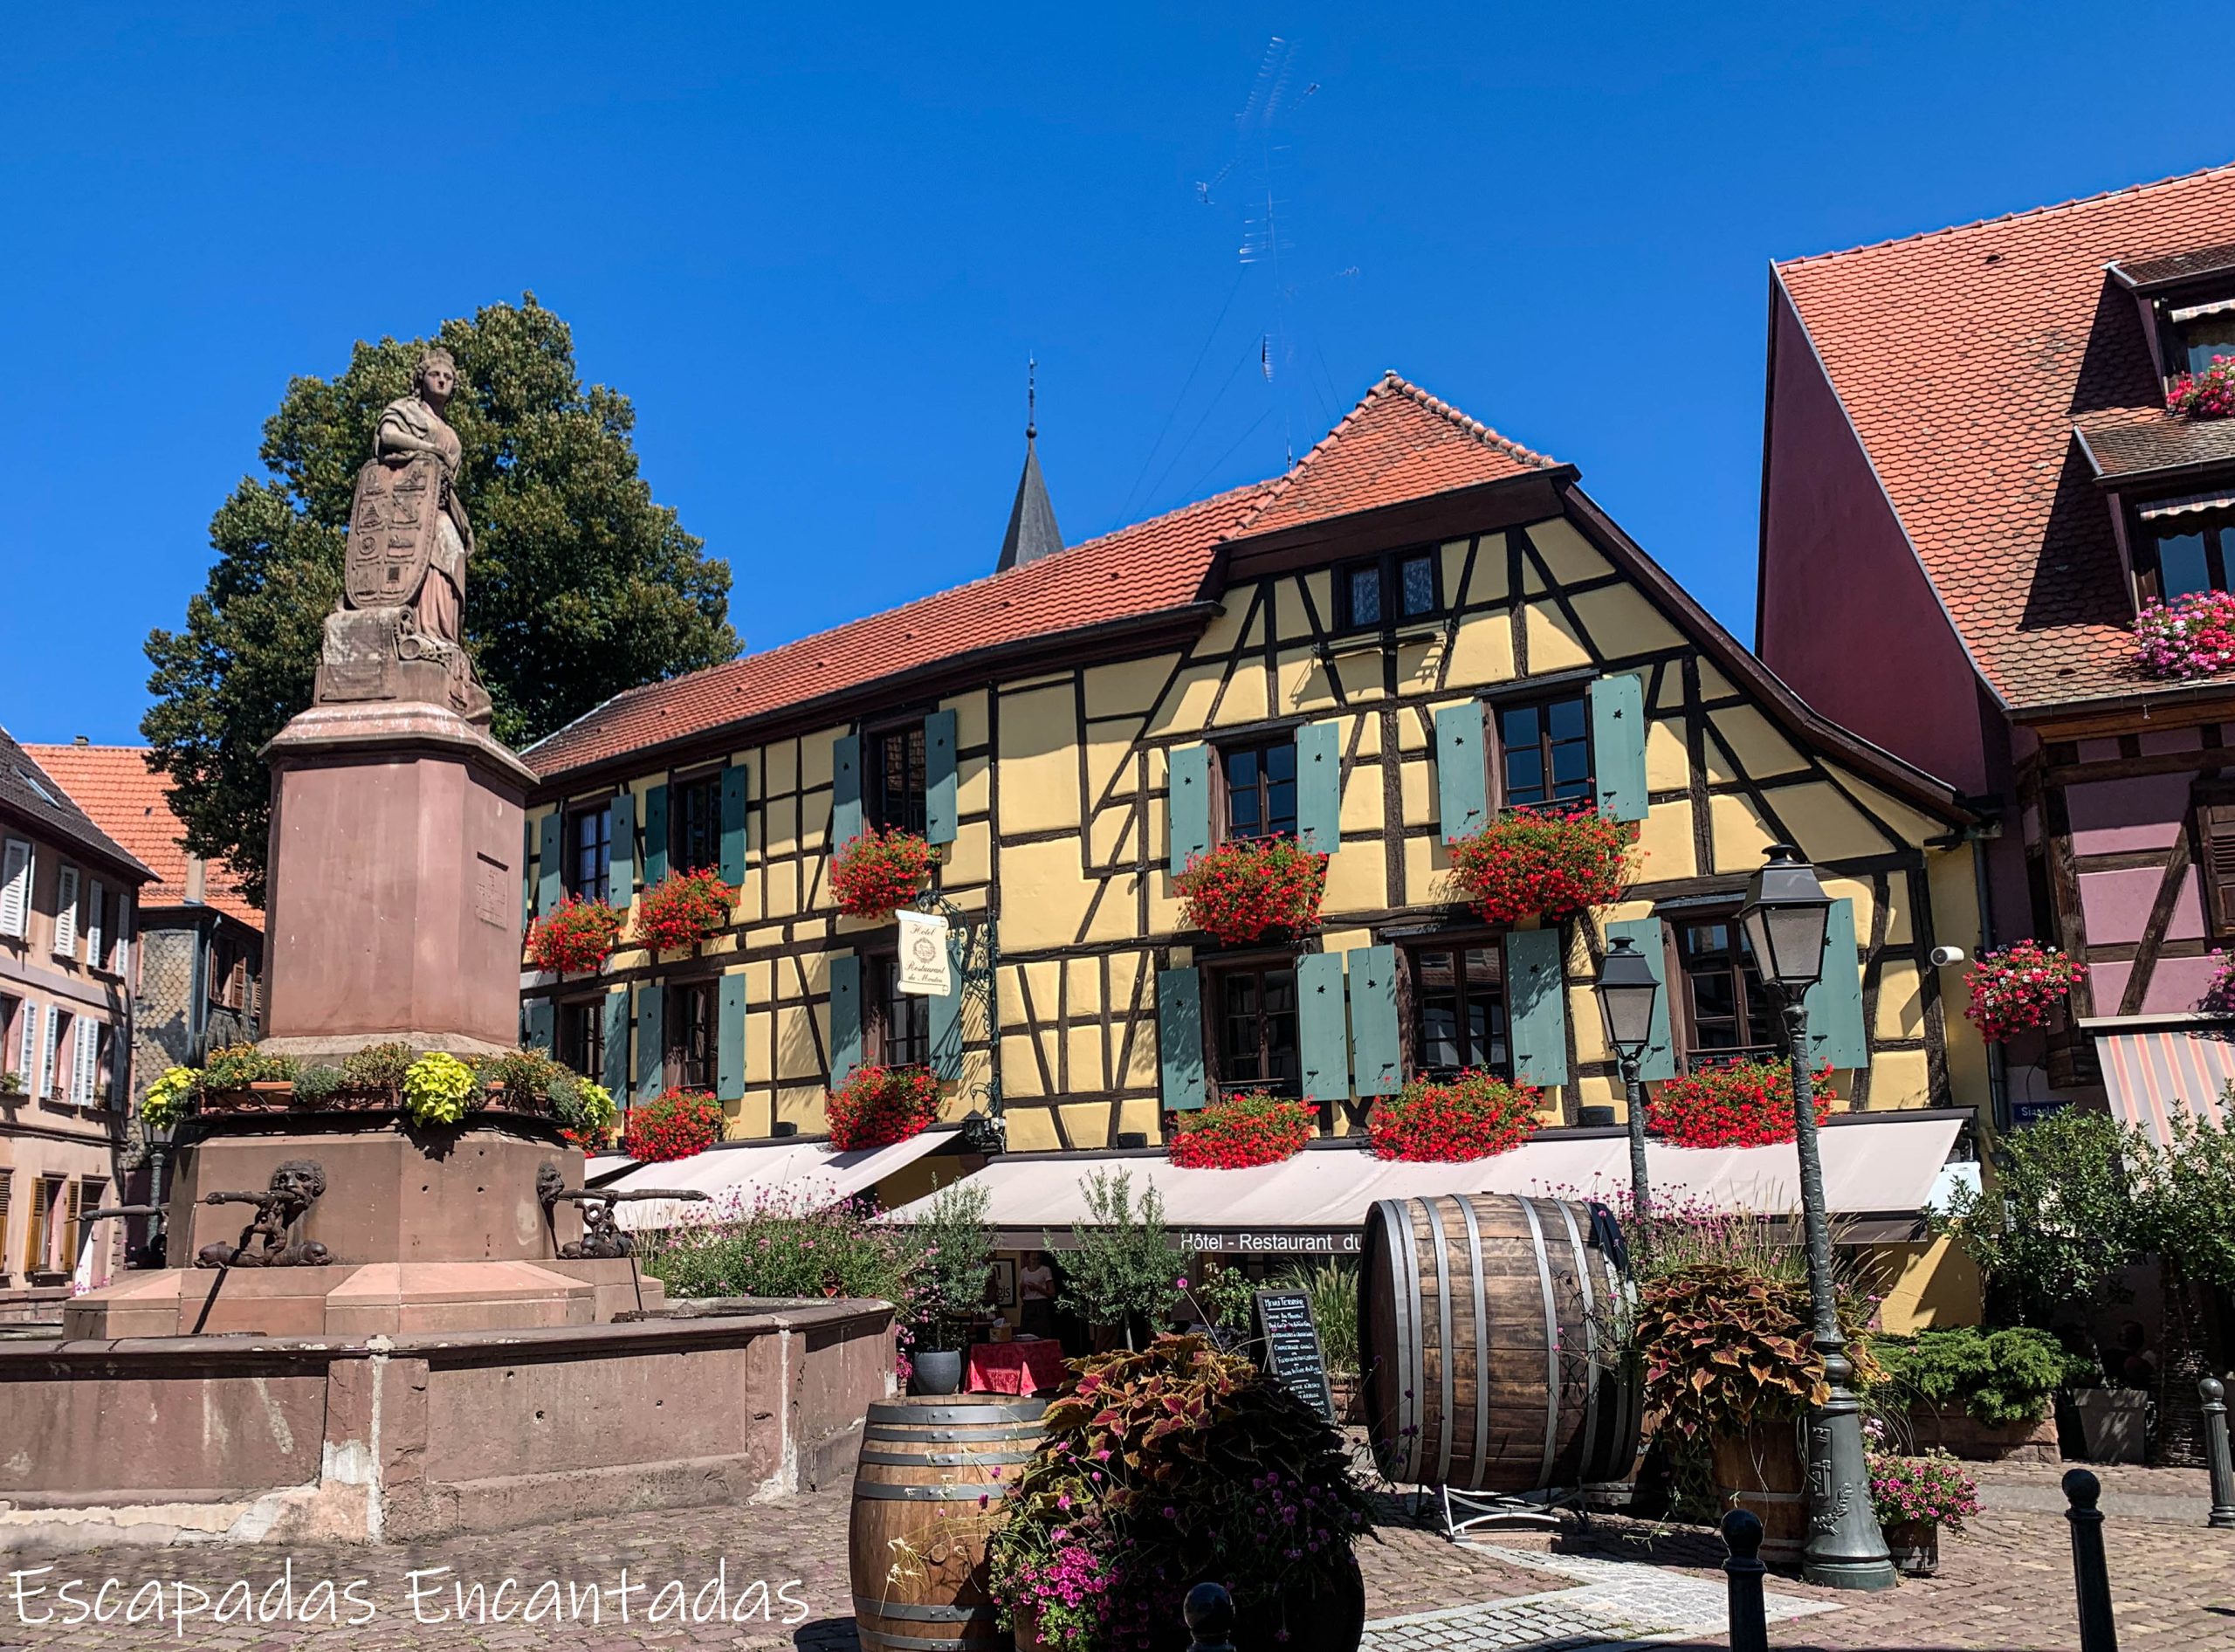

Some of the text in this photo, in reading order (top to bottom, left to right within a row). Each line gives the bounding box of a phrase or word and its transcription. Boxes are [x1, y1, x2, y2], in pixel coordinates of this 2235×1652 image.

[904, 960, 946, 974] Restaurant
[1181, 1233, 1223, 1250] Hôtel
[1240, 1233, 1333, 1250] Restaurant
